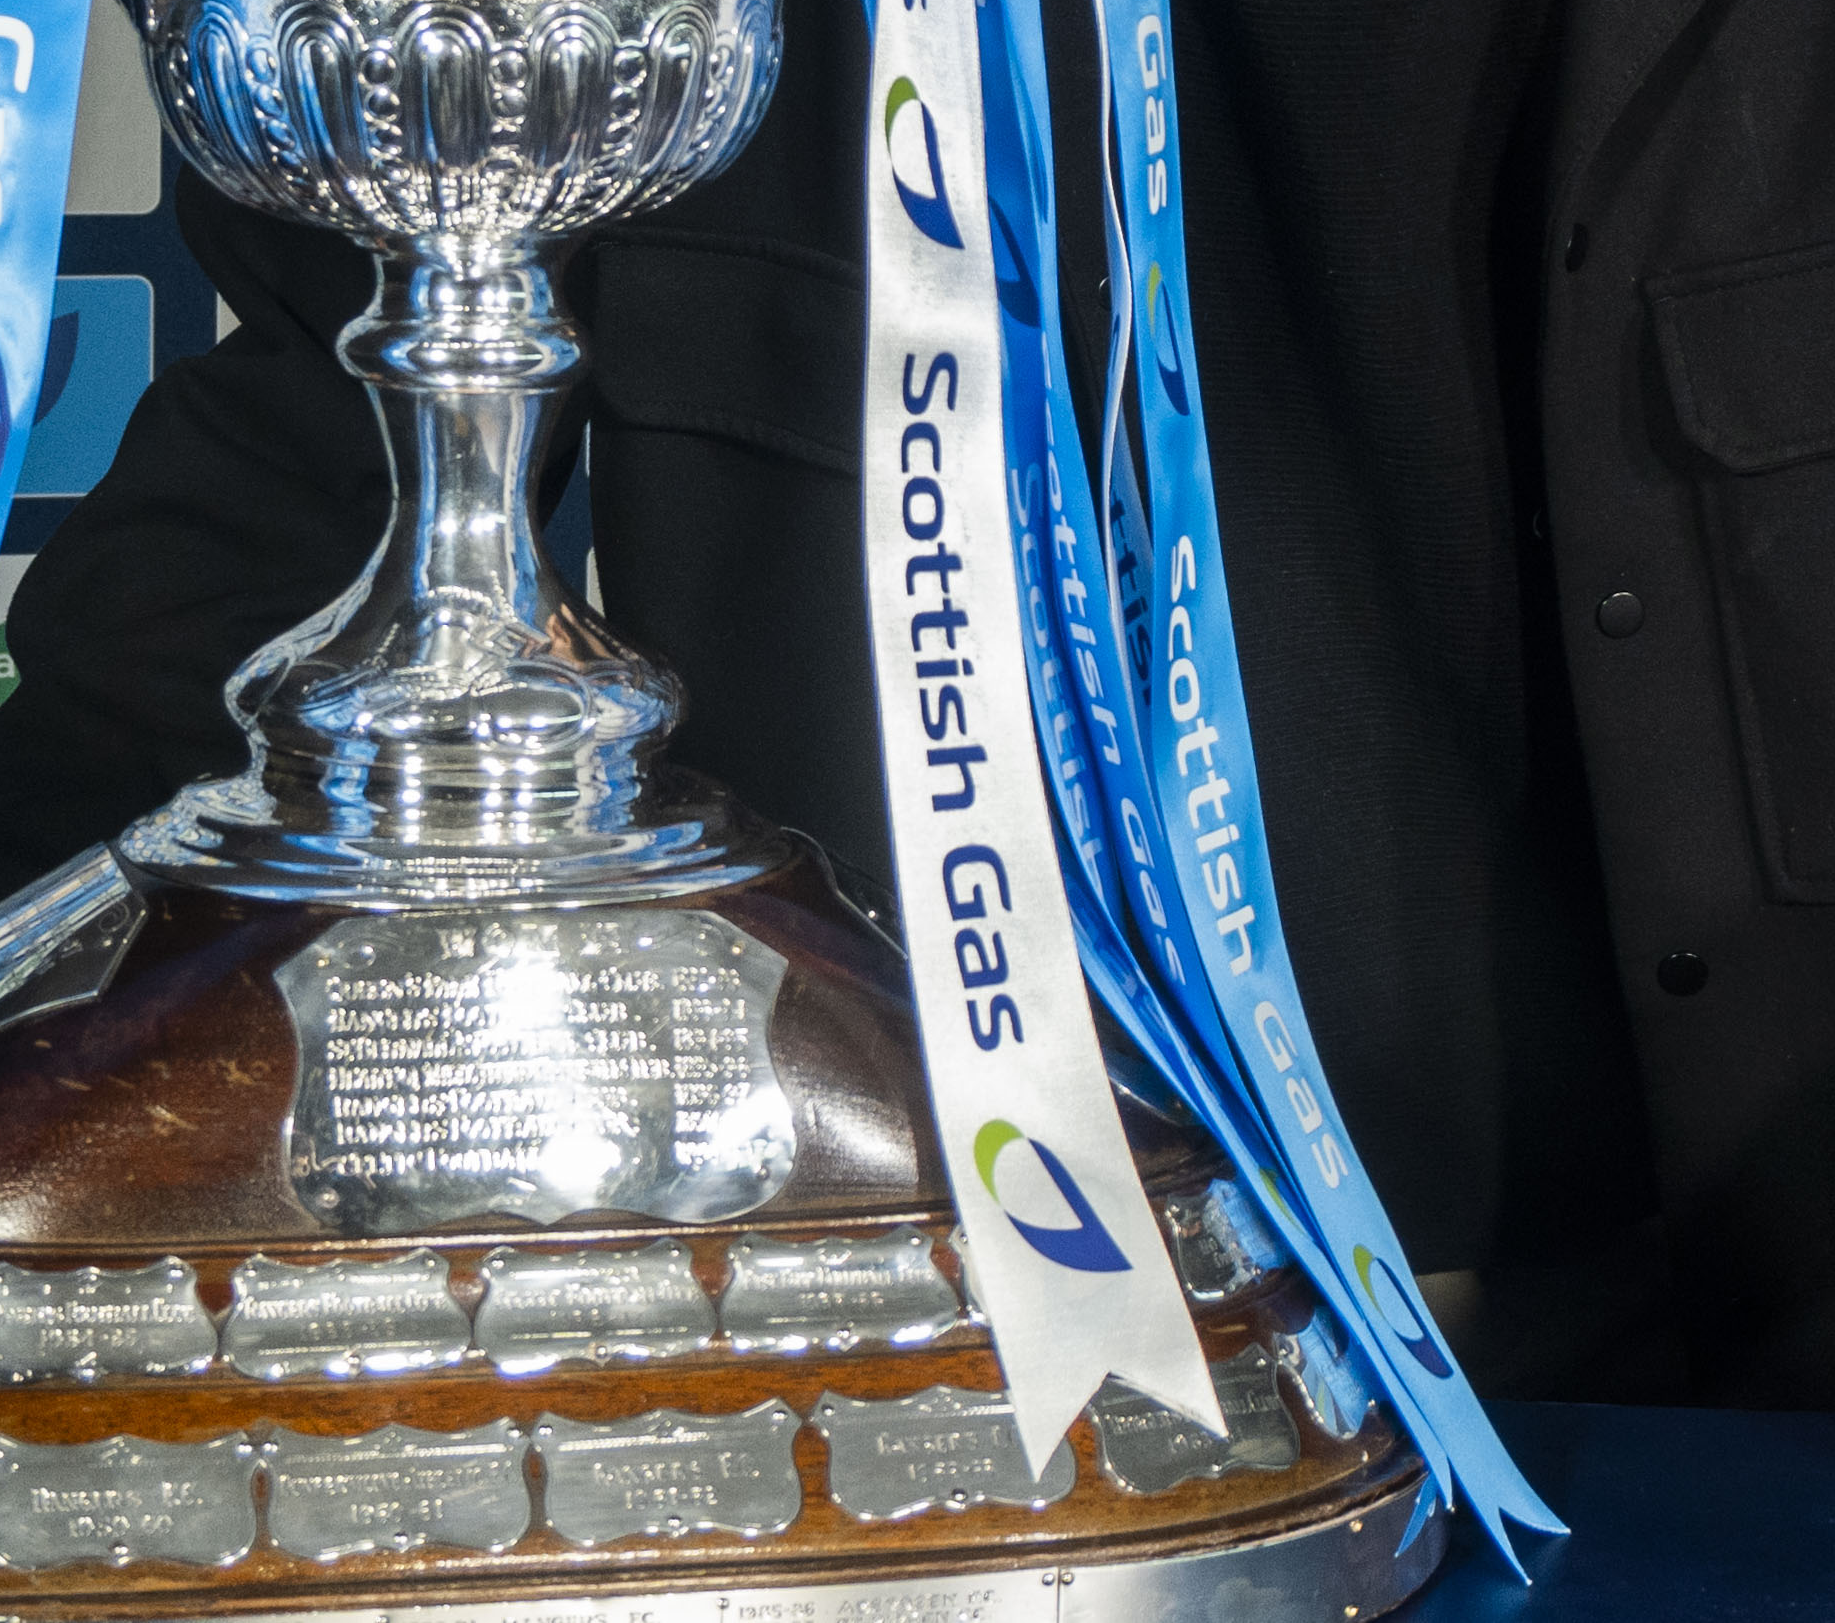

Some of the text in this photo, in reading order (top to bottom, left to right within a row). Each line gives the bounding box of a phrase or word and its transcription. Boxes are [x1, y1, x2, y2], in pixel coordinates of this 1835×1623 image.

[1136, 13, 1170, 217] Gas
[899, 350, 1025, 1053] Scottish Gas
[1120, 796, 1187, 987] Gas
[1166, 533, 1350, 1190] Scottish Gas
